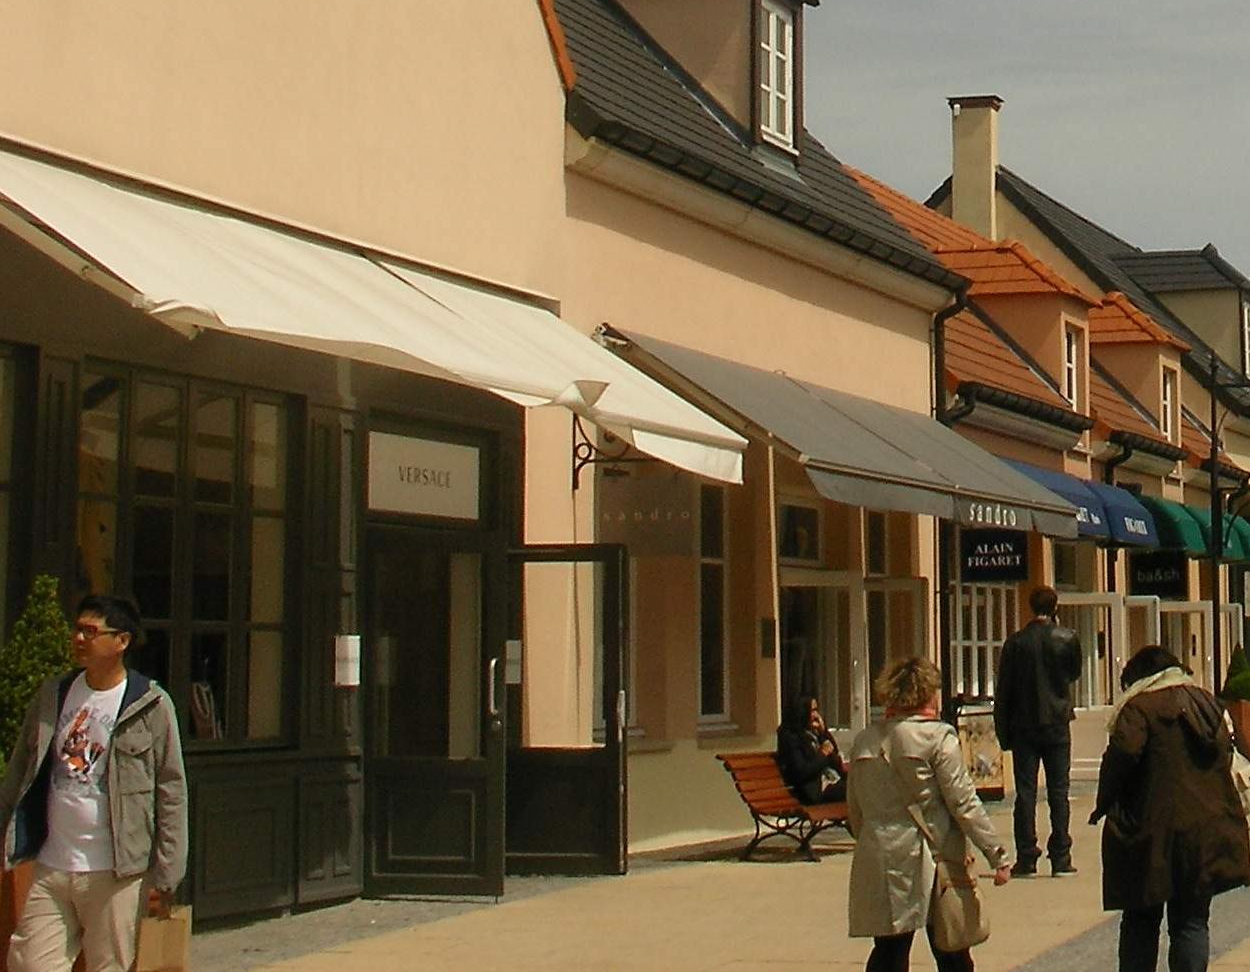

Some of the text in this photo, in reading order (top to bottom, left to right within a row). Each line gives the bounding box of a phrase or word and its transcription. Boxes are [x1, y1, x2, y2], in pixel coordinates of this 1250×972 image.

[398, 465, 451, 489] VERSACE
[969, 503, 1017, 526] sandro
[975, 543, 1014, 554] ALAIN
[967, 555, 1021, 567] FIGARET
